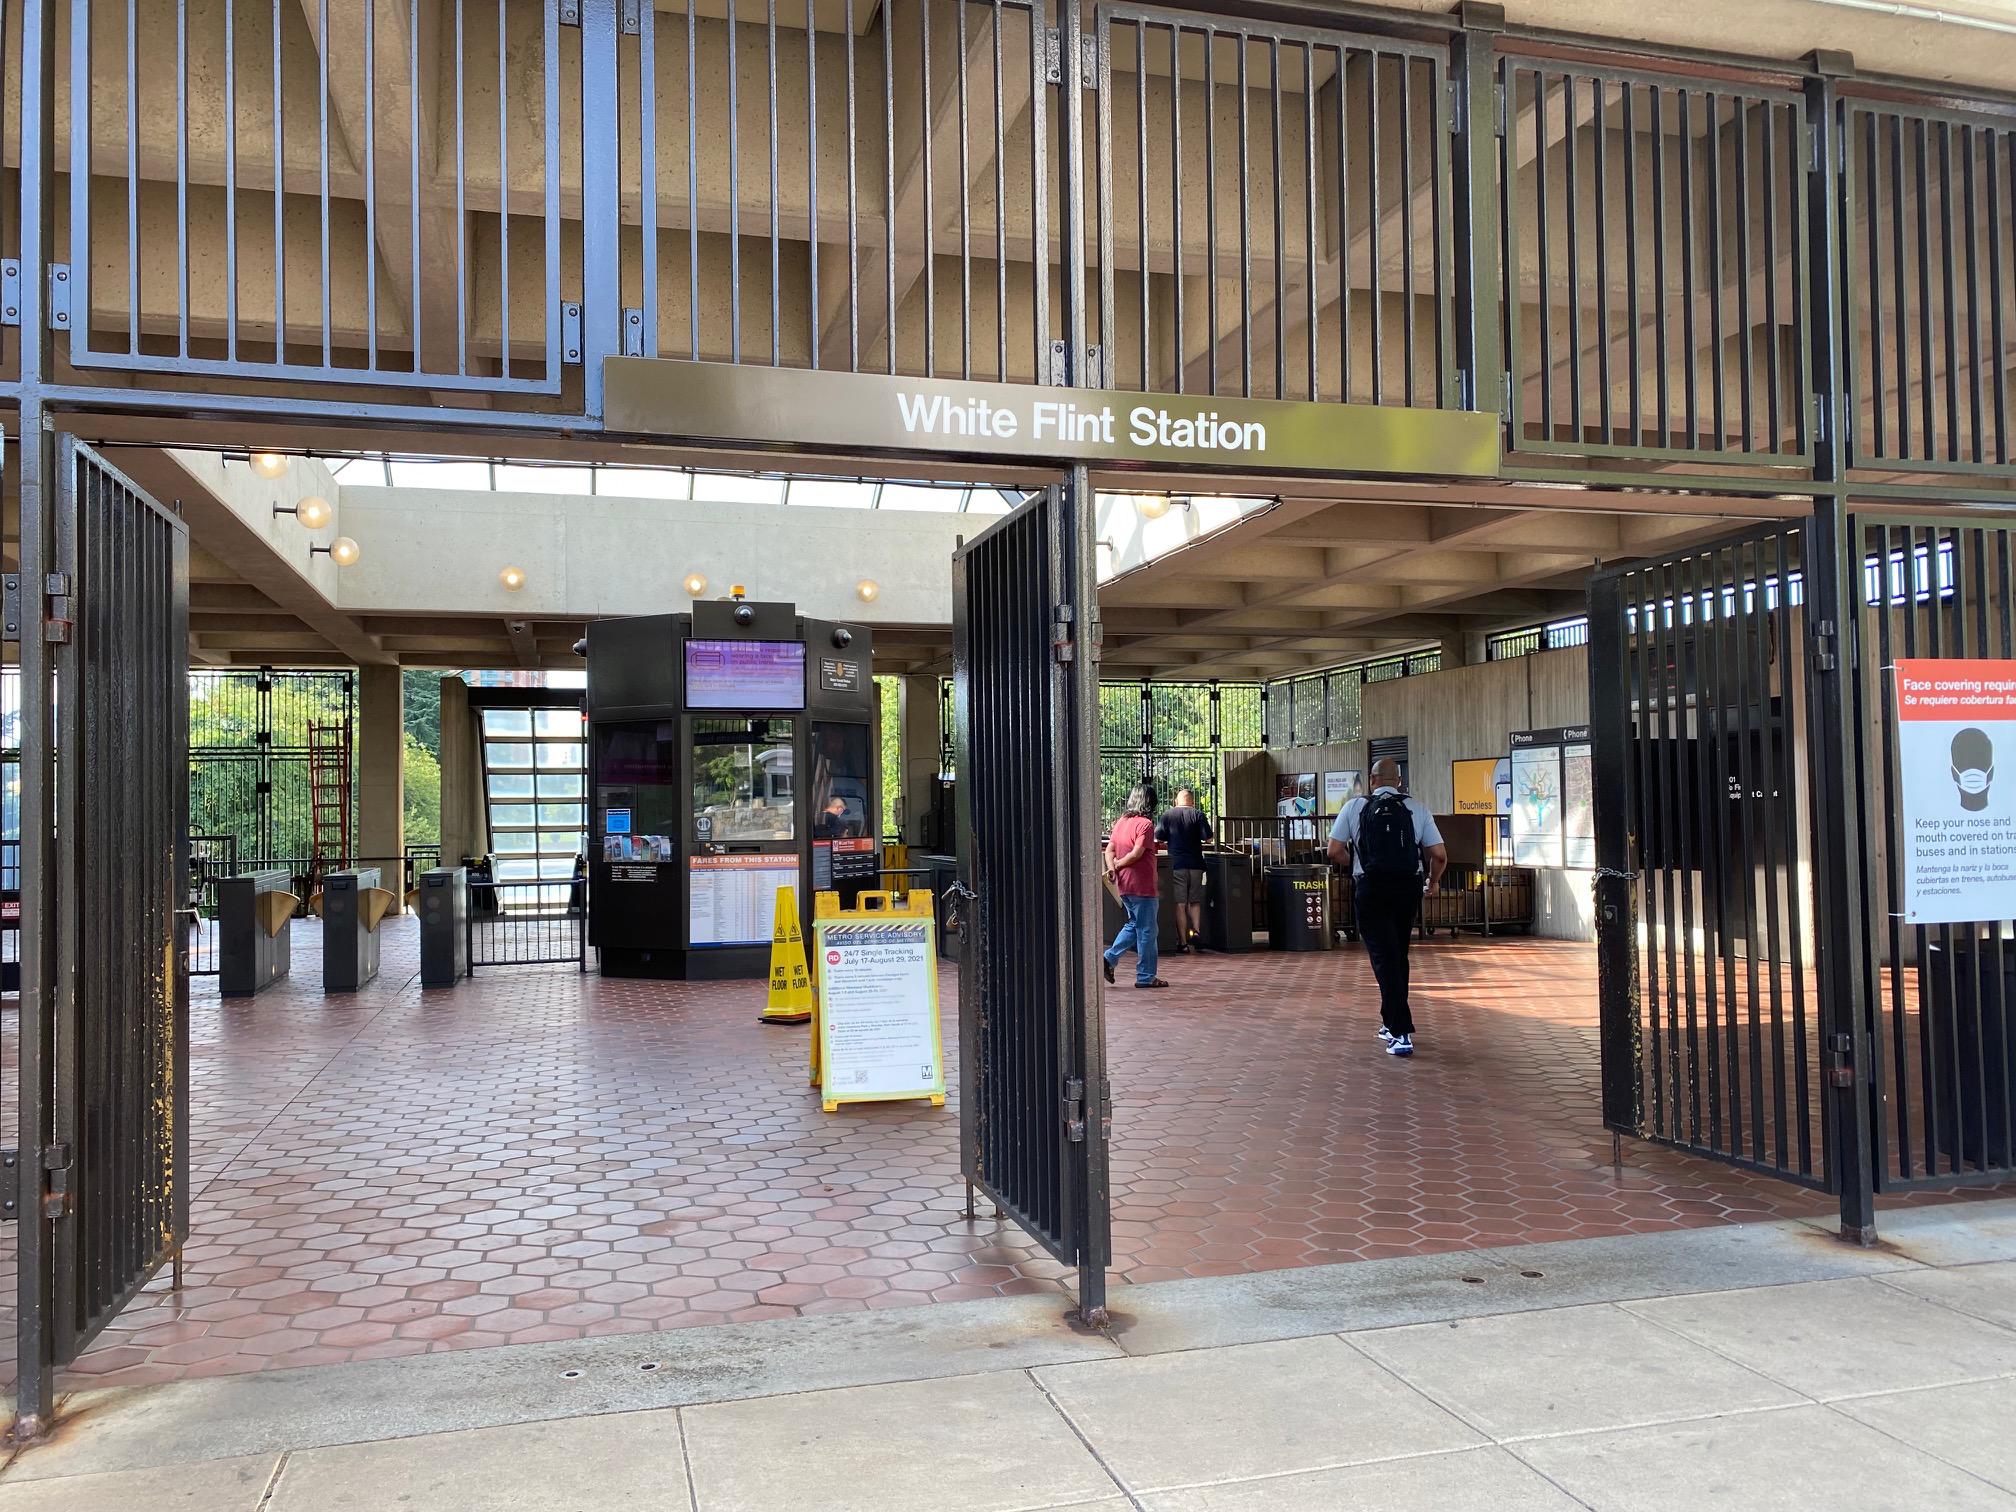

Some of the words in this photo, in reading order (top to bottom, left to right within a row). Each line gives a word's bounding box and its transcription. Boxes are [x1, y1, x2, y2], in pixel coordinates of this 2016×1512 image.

[896, 392, 1018, 438] White
[1033, 402, 1115, 443] Flint
[1129, 406, 1266, 451] Station
[1904, 678, 1932, 690] Face
[1934, 679, 1981, 692] covering
[1904, 695, 1917, 704] Se
[1920, 695, 1958, 706] requiere
[1960, 695, 2004, 704] cobertura
[1568, 730, 1588, 738] Phone
[1458, 800, 1492, 810] Touchless
[1915, 818, 1940, 830] Keep
[1943, 819, 1964, 830] your
[1968, 818, 1991, 827] nose
[1993, 816, 2011, 826] and
[1916, 832, 1947, 843] mouth
[1950, 831, 1988, 842] covered
[1991, 832, 2004, 840] on
[1916, 847, 1945, 857] buses
[1948, 846, 1966, 856] and
[1969, 845, 1978, 855] in
[1916, 865, 1951, 874] Mantenga
[1953, 864, 1959, 872] la
[1916, 876, 1949, 884] cubiertas
[1293, 881, 1324, 890] TRASH
[861, 949, 882, 958] Single
[772, 980, 787, 990] FLOOR
[792, 978, 808, 989] FLOOR
